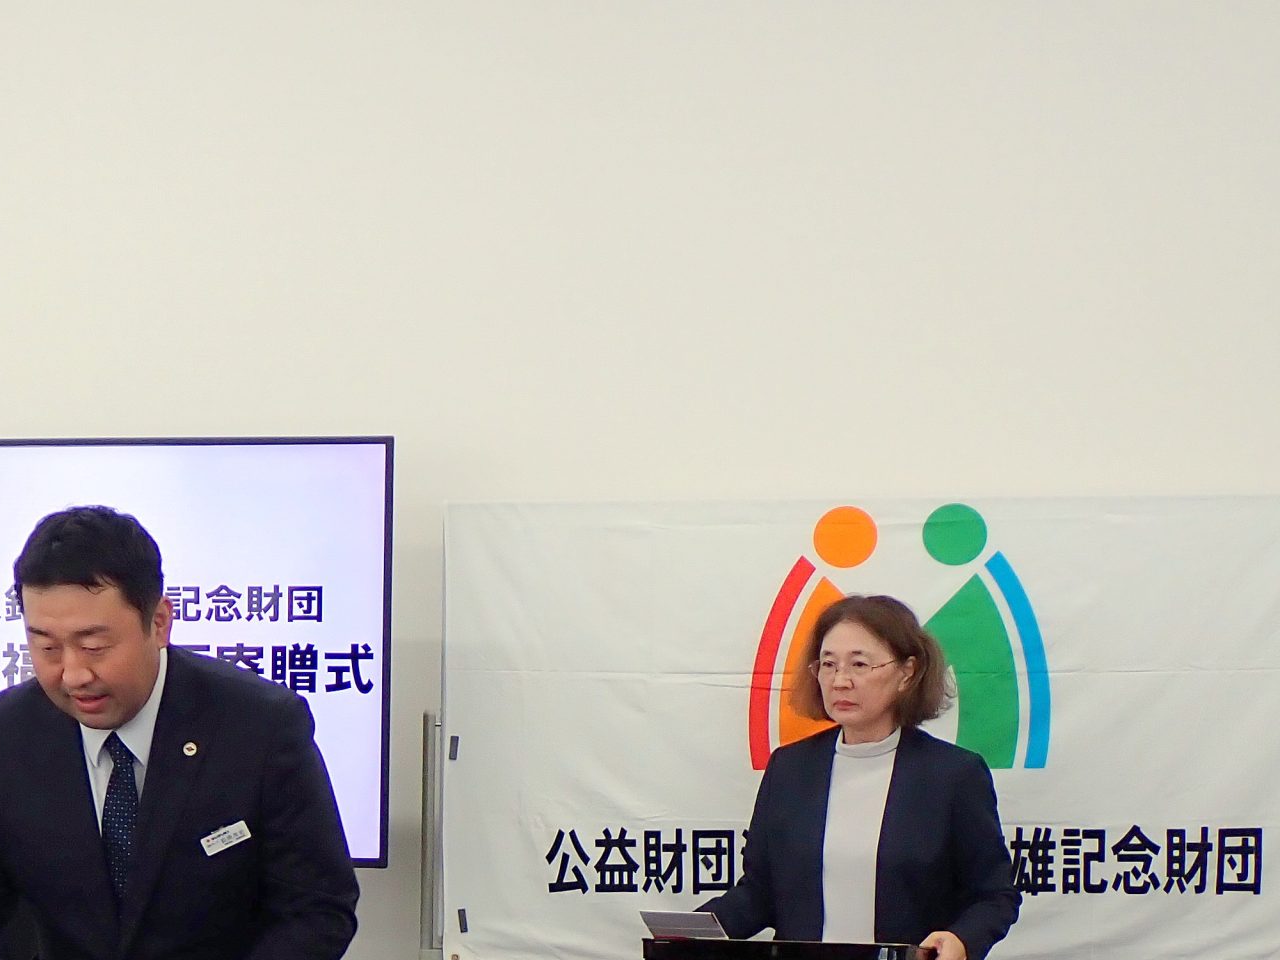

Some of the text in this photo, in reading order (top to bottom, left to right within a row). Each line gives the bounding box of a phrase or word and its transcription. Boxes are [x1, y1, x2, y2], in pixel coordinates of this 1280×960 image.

[165, 584, 323, 622] 記念財団
[545, 824, 1262, 895] 公益財団 雄記念財団
